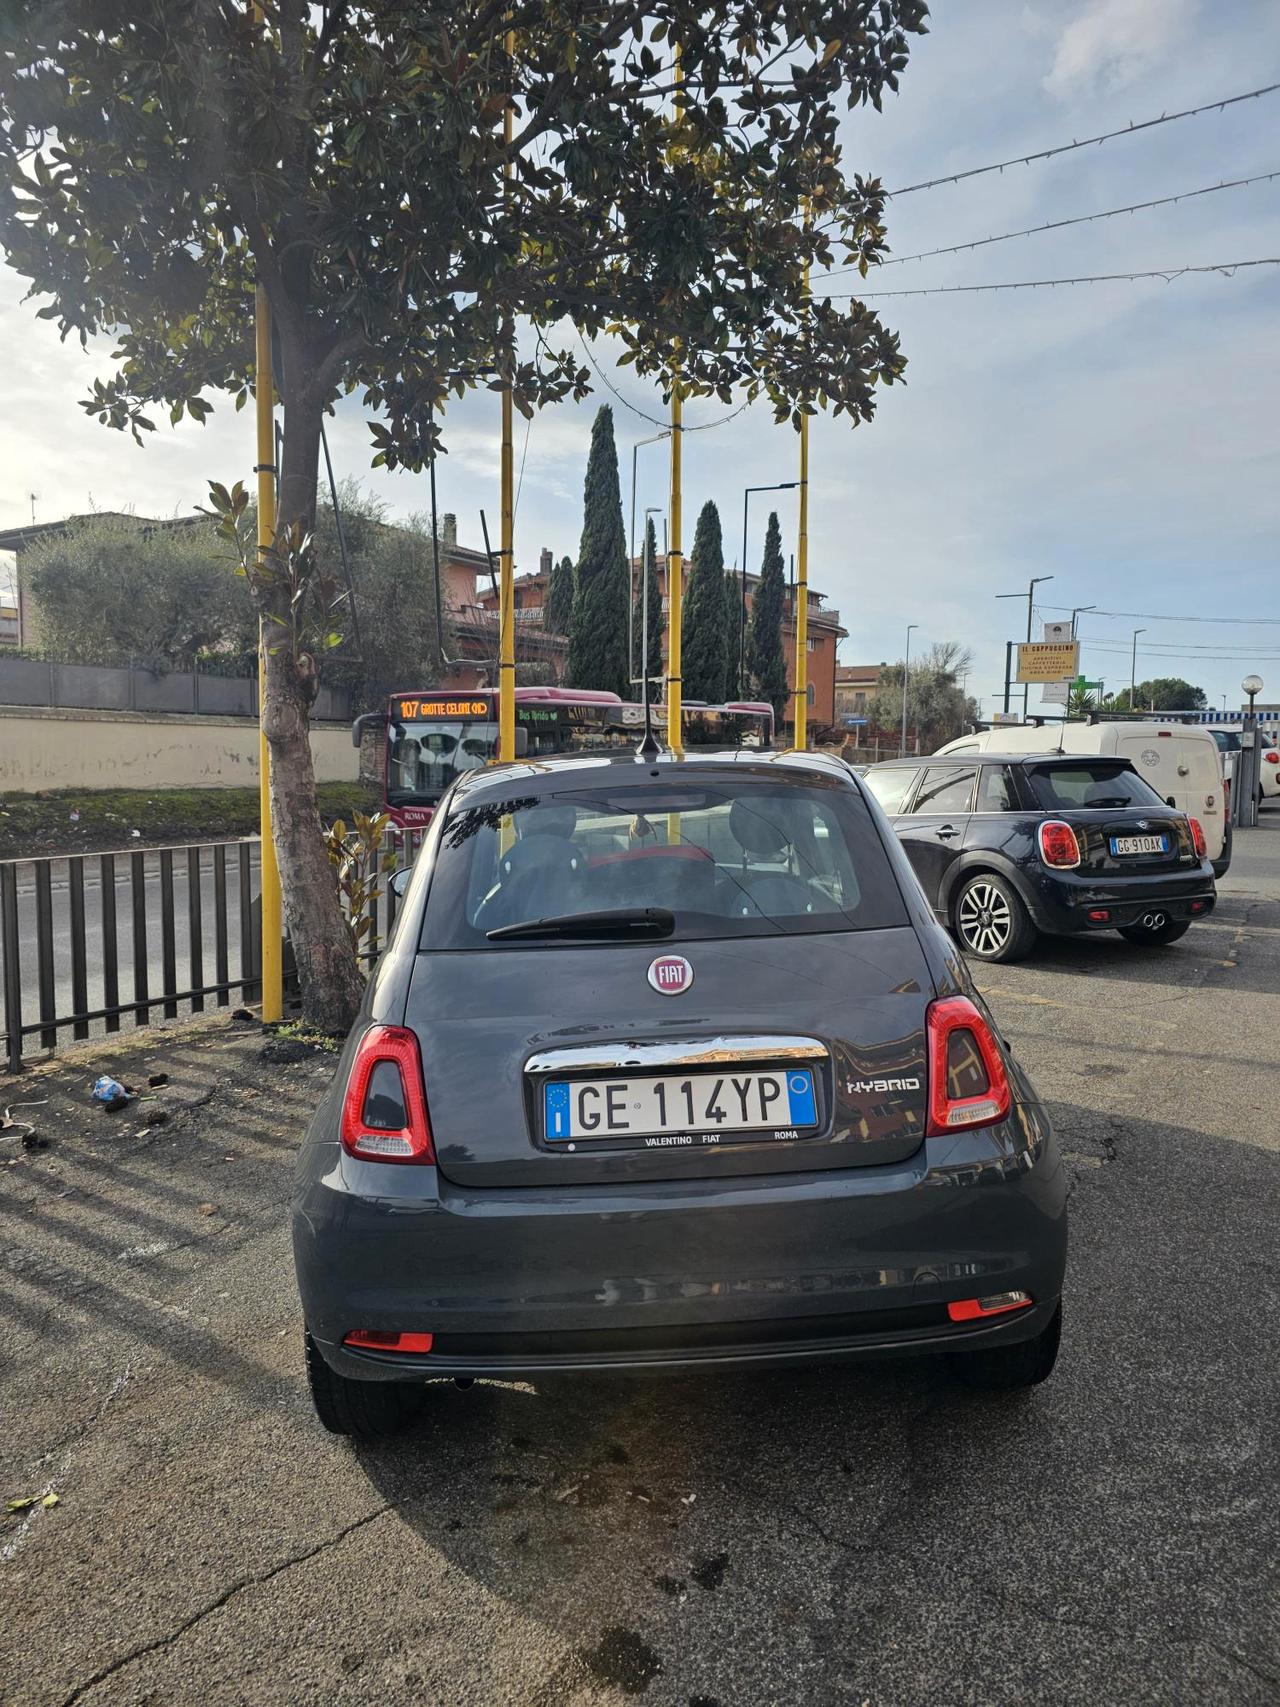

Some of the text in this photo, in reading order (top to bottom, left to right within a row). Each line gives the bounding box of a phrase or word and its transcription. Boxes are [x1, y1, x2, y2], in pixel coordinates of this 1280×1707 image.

[401, 701, 420, 718] 107
[420, 703, 446, 715] GROTTE
[446, 702, 471, 715] CELONI
[519, 710, 531, 720] Bus
[404, 812, 425, 820] ROMA
[1117, 837, 1162, 853] GG 910AK
[658, 965, 684, 984] FIAT
[846, 1078, 920, 1094] HYBRID
[577, 1077, 781, 1131] GE 114YP
[645, 1130, 799, 1146] VALENTINO FIAT ROMA
